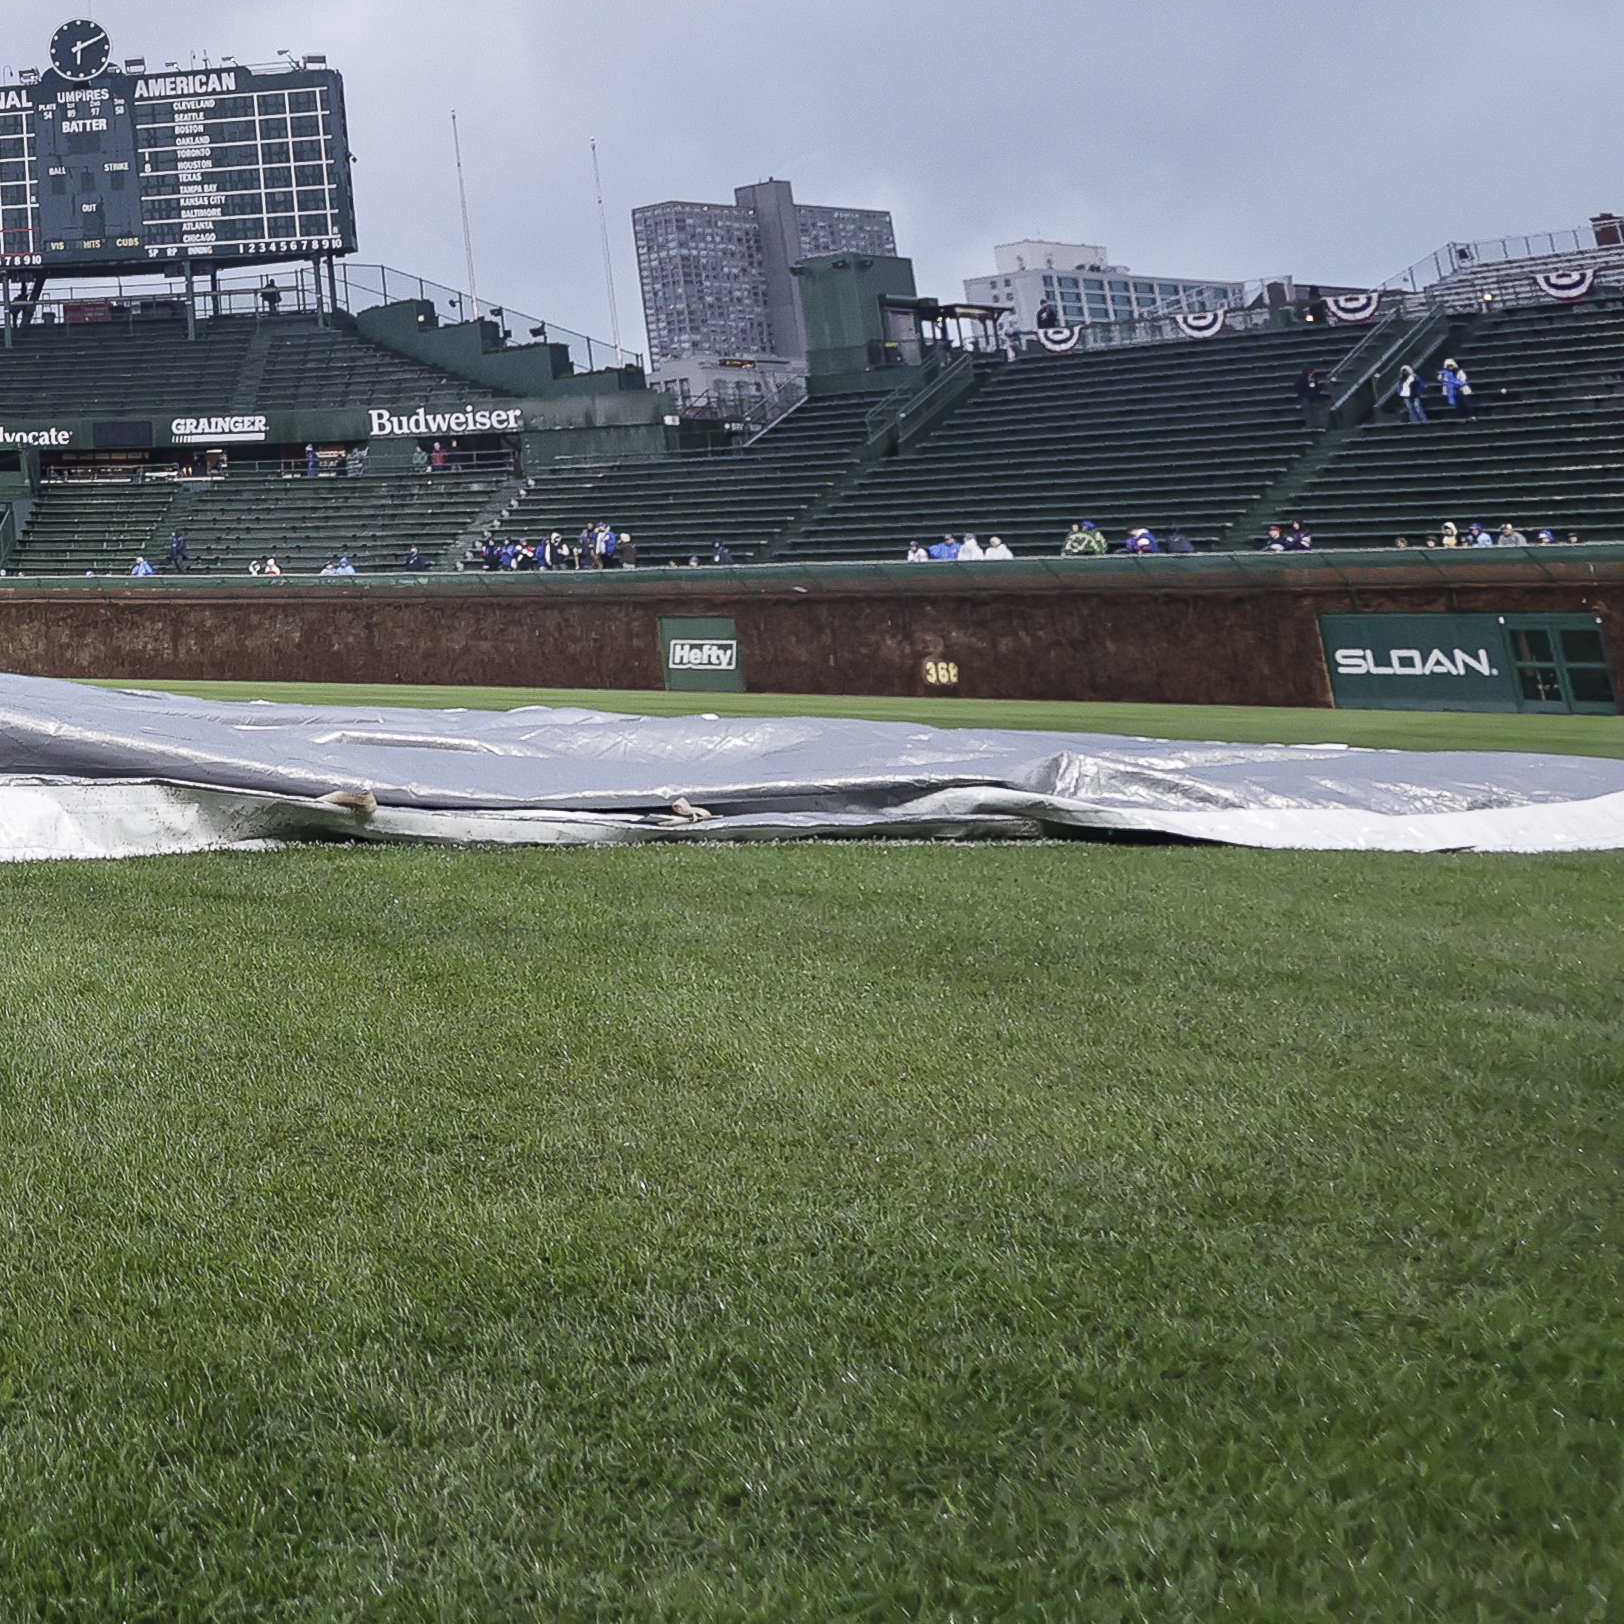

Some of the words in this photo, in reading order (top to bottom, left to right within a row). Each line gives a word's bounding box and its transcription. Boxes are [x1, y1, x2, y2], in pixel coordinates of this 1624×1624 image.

[134, 72, 236, 98] AMERICAN
[57, 89, 109, 103] UMPIRES
[173, 99, 215, 110] CLEVELAND
[91, 108, 100, 116] 97
[174, 112, 205, 122] SEATTLE
[62, 118, 107, 133] BATTER
[175, 124, 203, 134] BOSTON
[176, 135, 210, 146] OAKLAND
[177, 148, 211, 158] TORONTO
[104, 162, 129, 171] STRIKE
[177, 160, 212, 170] HOUSTON
[49, 167, 66, 175] BALL
[179, 173, 202, 182] TEXAS
[179, 185, 202, 194] TAMPA
[204, 184, 217, 192] BAY
[180, 197, 208, 206] KANSAS
[210, 196, 225, 205] CITY
[82, 204, 97, 212] OUT
[181, 208, 221, 218] BALTIMORE
[182, 221, 213, 231] ATLANTA
[116, 238, 139, 247] CUBS
[183, 233, 216, 243] CHICAGO
[239, 243, 244, 254] 1
[248, 243, 255, 253] 2
[259, 242, 266, 252] 3
[269, 242, 276, 251] 4
[280, 241, 287, 251] 5
[290, 241, 297, 250] 6
[301, 240, 308, 250] 7
[312, 240, 319, 249] 8
[322, 239, 329, 249] 9
[332, 238, 343, 249] 10
[4, 256, 12, 266] 7
[14, 256, 21, 265] 8
[23, 255, 31, 265] 9
[32, 254, 42, 265] 10
[171, 416, 266, 434] GRAINGER
[368, 405, 521, 435] Budweiser
[673, 644, 733, 666] Hefty
